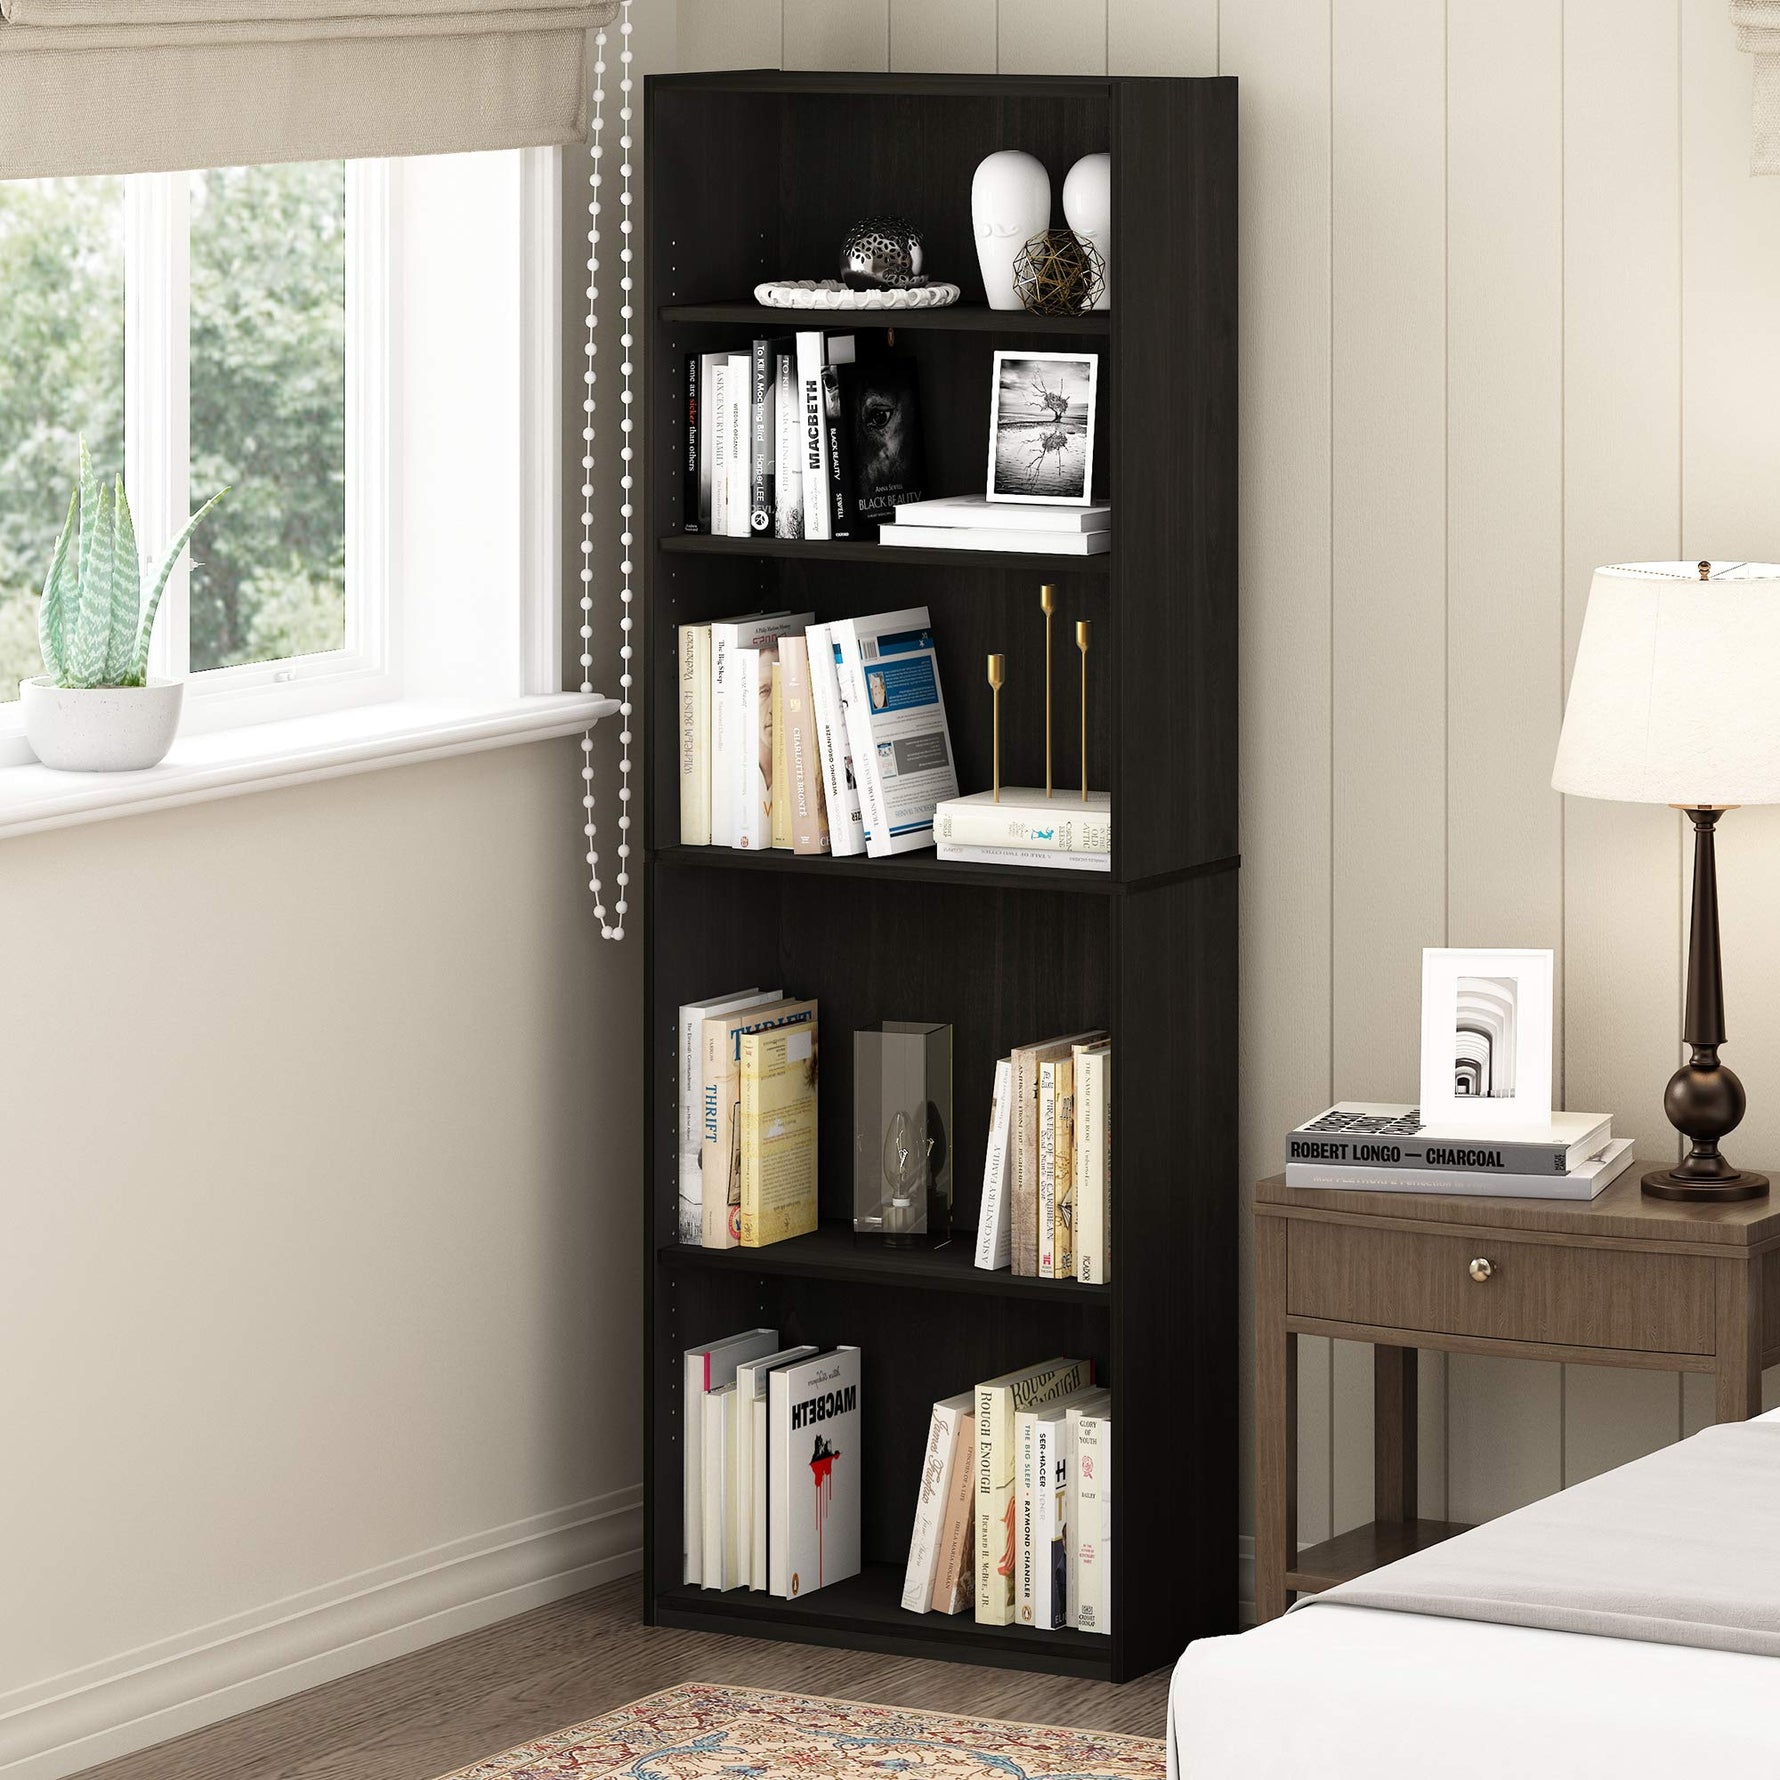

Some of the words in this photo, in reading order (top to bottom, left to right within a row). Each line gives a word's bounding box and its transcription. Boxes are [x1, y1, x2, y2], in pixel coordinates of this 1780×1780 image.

[757, 346, 765, 356] To
[757, 358, 765, 371] Kill
[757, 373, 765, 381] A
[782, 357, 790, 373] TO
[688, 398, 698, 425] sicker
[716, 392, 724, 433] CENTURY
[756, 382, 765, 422] Mocking
[688, 426, 697, 444] than
[756, 424, 765, 441] Bird
[806, 380, 820, 470] MACBETH
[716, 435, 724, 467] FAMILY
[830, 428, 839, 450] BLACK
[688, 445, 697, 472] others
[756, 454, 764, 485] Harper
[833, 450, 841, 480] BEAUTY
[756, 486, 765, 502] LEE
[836, 493, 844, 519] SEWELL
[858, 496, 887, 511] BLACK
[887, 490, 922, 507] BEAUTY
[717, 654, 725, 665] Big
[716, 665, 725, 684] Sleep
[793, 727, 804, 779] CHARLOTTE
[825, 725, 835, 763] ORGANIZER
[831, 764, 839, 796] WEDDING
[1083, 822, 1091, 849] ATTIC
[1091, 829, 1099, 847] OLD
[705, 1085, 718, 1143] THRIFT
[1045, 1099, 1054, 1137] PIRATES
[1046, 1139, 1054, 1156] OF
[1290, 1141, 1349, 1160] ROBERT
[1352, 1144, 1401, 1163] LONGO
[1426, 1148, 1505, 1168] CHARCOAL
[991, 1145, 1001, 1186] FAMILY
[1046, 1161, 1054, 1181] THE
[984, 1186, 997, 1238] CENTURY
[1045, 1182, 1054, 1240] CARIBBEAN
[982, 1238, 991, 1254] SIX
[1083, 1256, 1091, 1281] PICADOR
[981, 1392, 992, 1436] ROUGH
[1080, 1420, 1098, 1429] GLORY
[930, 1408, 949, 1453] James
[1079, 1437, 1098, 1445] YOUTH
[965, 1446, 973, 1474] EPISODES
[981, 1442, 992, 1494] ENOUGH
[982, 1514, 990, 1549] RICHARD
[949, 1541, 957, 1561] MARIA
[982, 1550, 989, 1559] H.
[945, 1561, 955, 1590] HOLMAN
